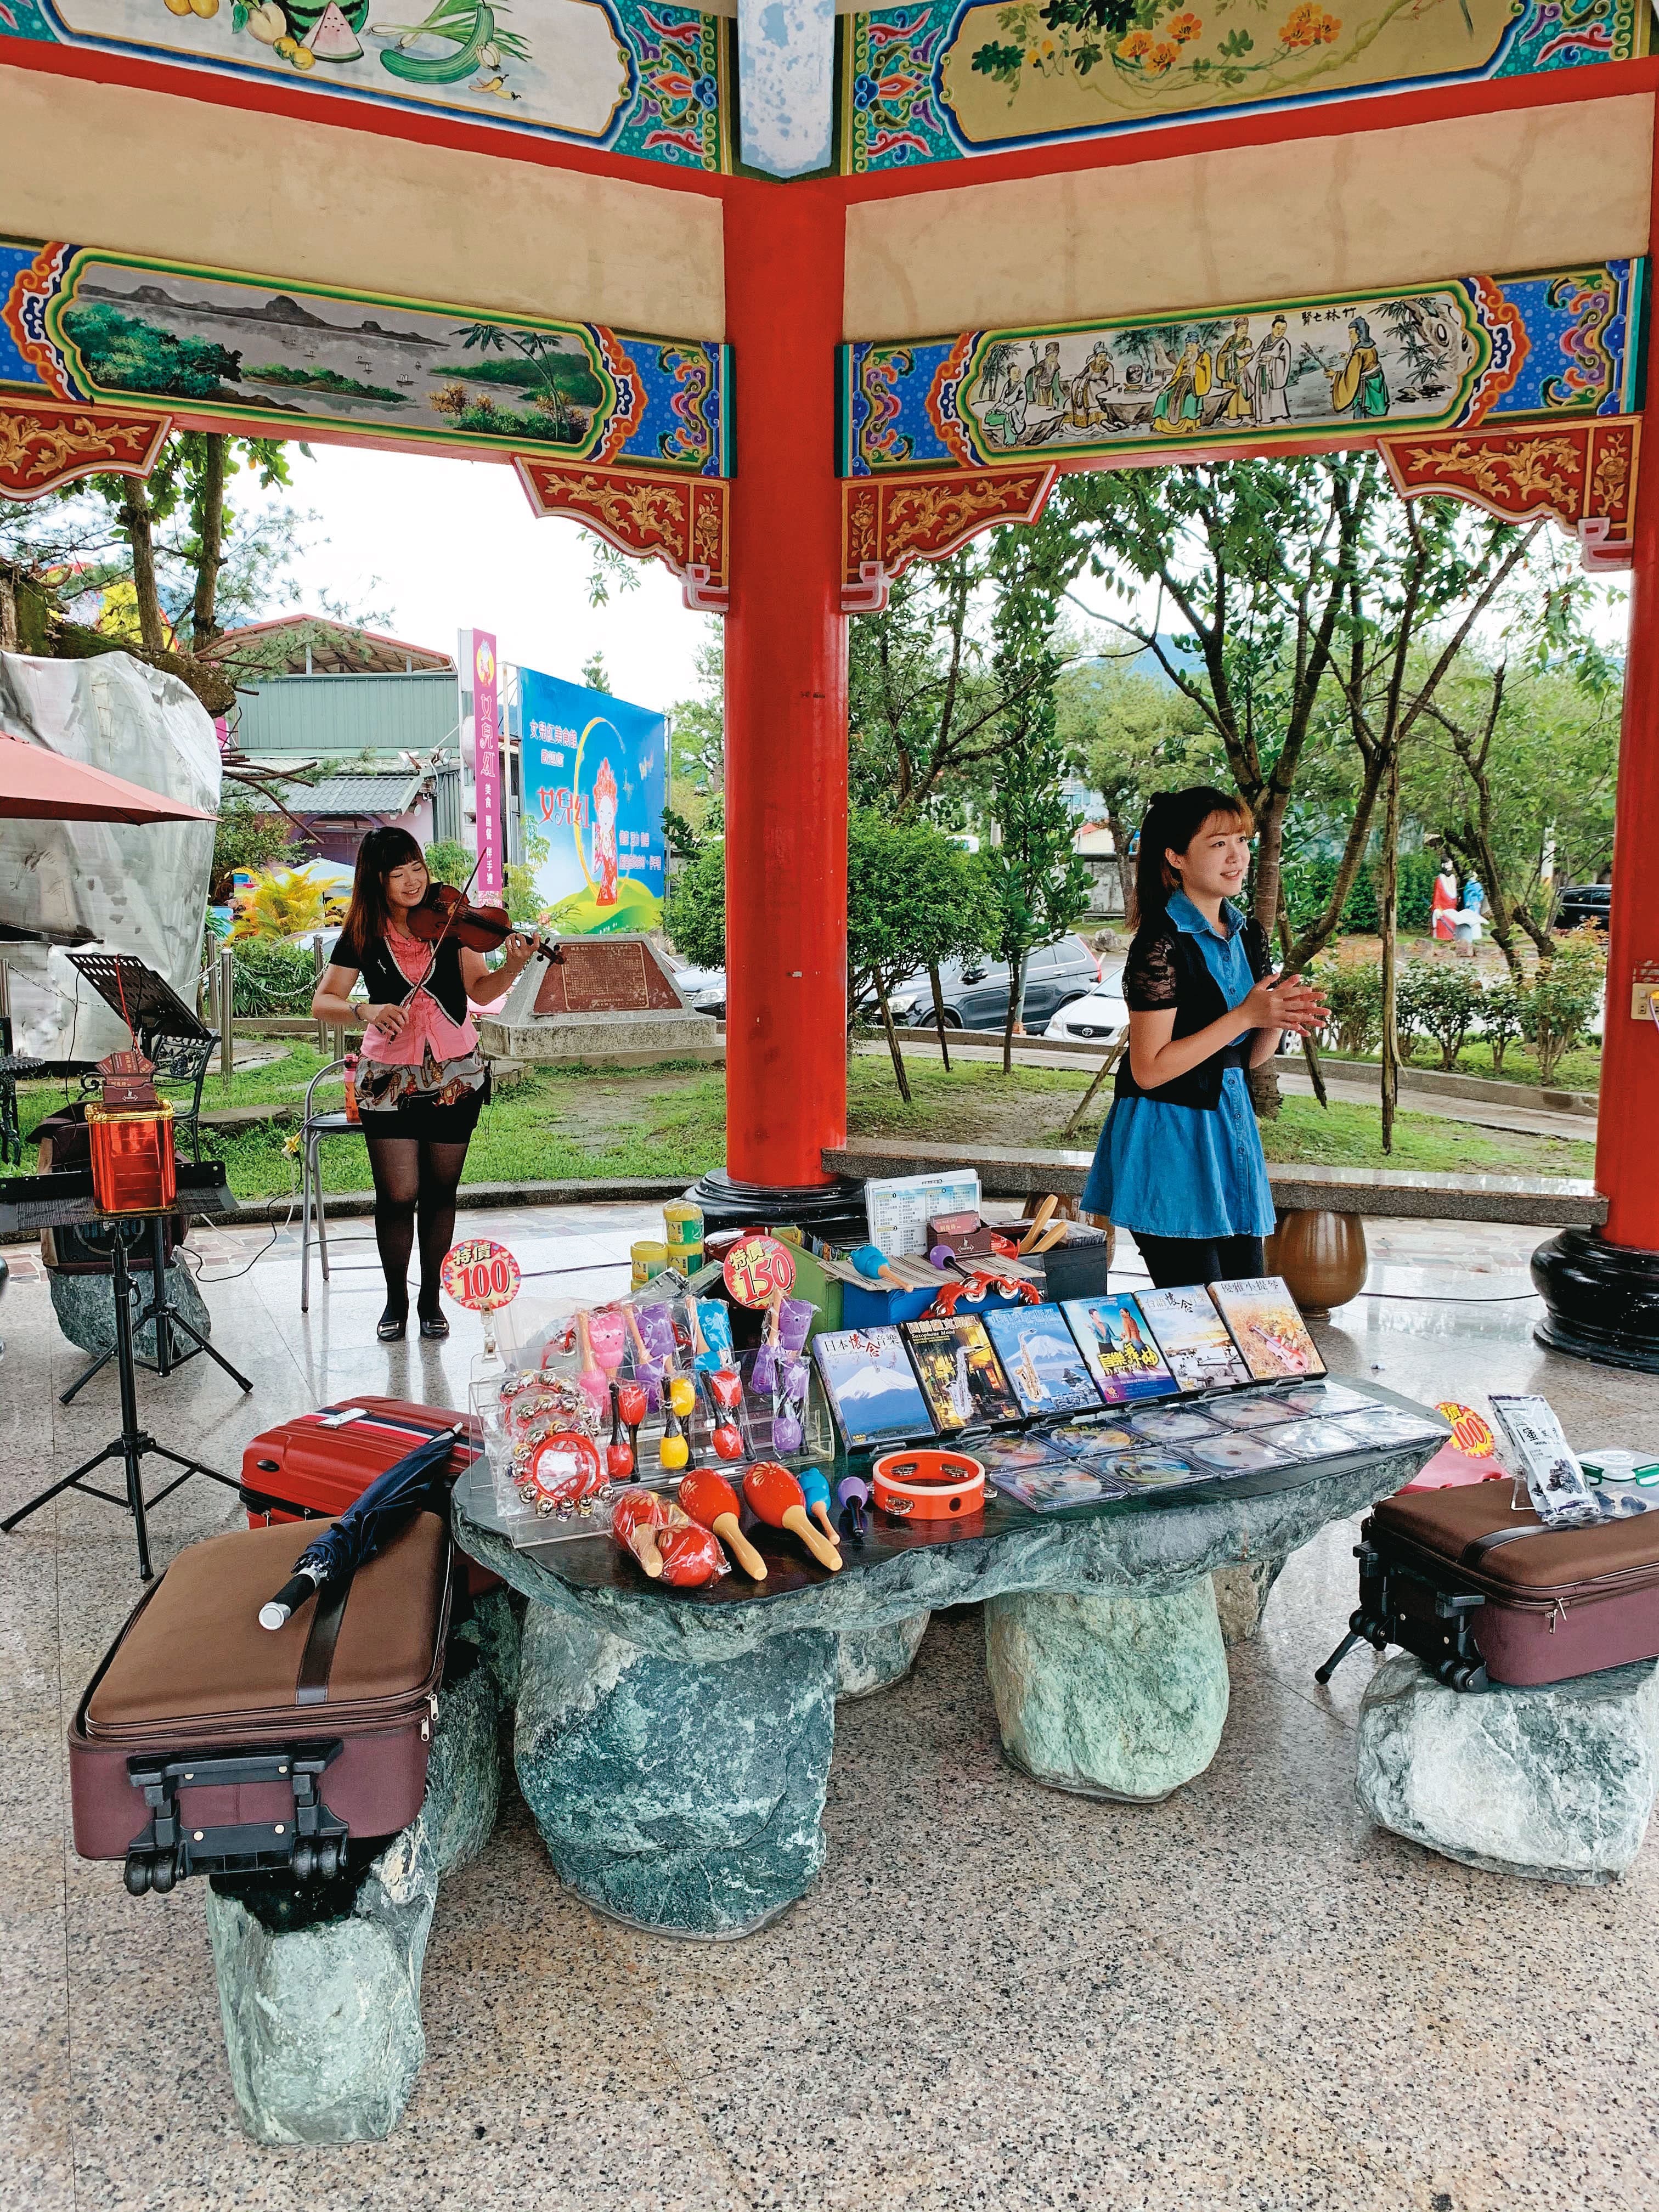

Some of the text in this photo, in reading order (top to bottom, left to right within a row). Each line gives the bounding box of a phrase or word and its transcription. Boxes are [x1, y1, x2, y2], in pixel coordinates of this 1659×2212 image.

[479, 693, 496, 777] 女兒紅
[529, 718, 578, 749] 女兒紅美食館
[540, 748, 564, 767] 歡迎您
[484, 783, 492, 808] 美食
[536, 786, 590, 828] 女兒紅
[453, 1243, 492, 1266] 特價
[730, 1239, 764, 1271] 特價
[456, 1259, 510, 1302] 100
[738, 1252, 792, 1305] 150
[825, 1334, 900, 1357] 日本懷念音樂
[1301, 1404, 1357, 1423] 竹林七賢
[1452, 1417, 1487, 1452] 100
